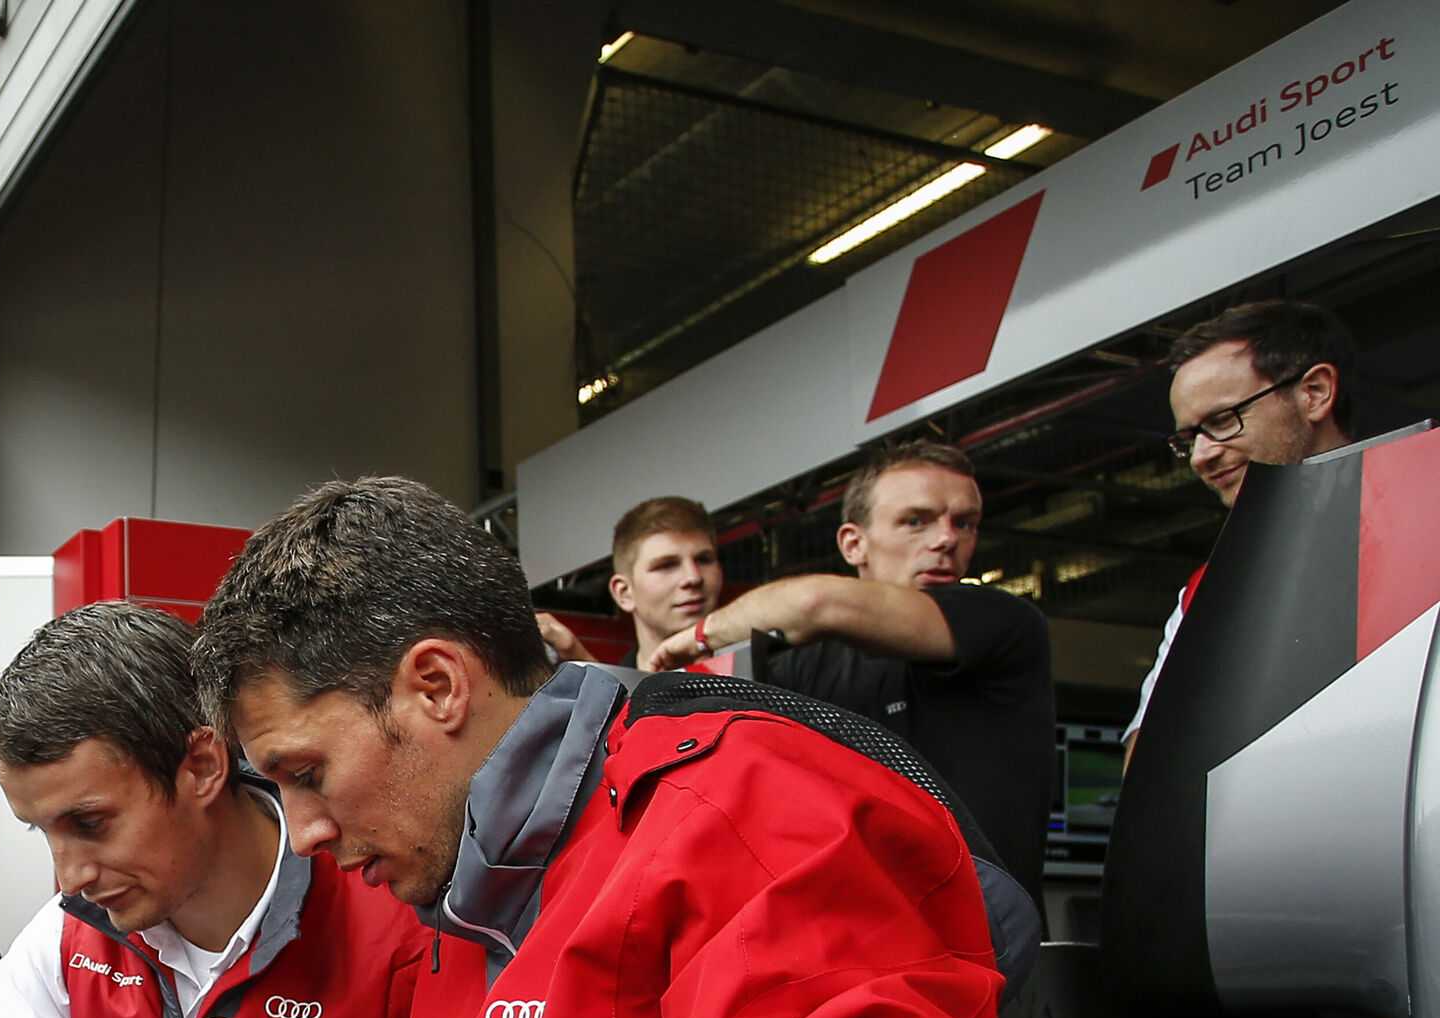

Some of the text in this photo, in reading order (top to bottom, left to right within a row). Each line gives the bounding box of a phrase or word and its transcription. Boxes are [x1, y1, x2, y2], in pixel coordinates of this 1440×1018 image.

[1184, 82, 1400, 200] Team Joest
[1185, 37, 1396, 163] Audi Sport
[82, 956, 112, 976] Audi
